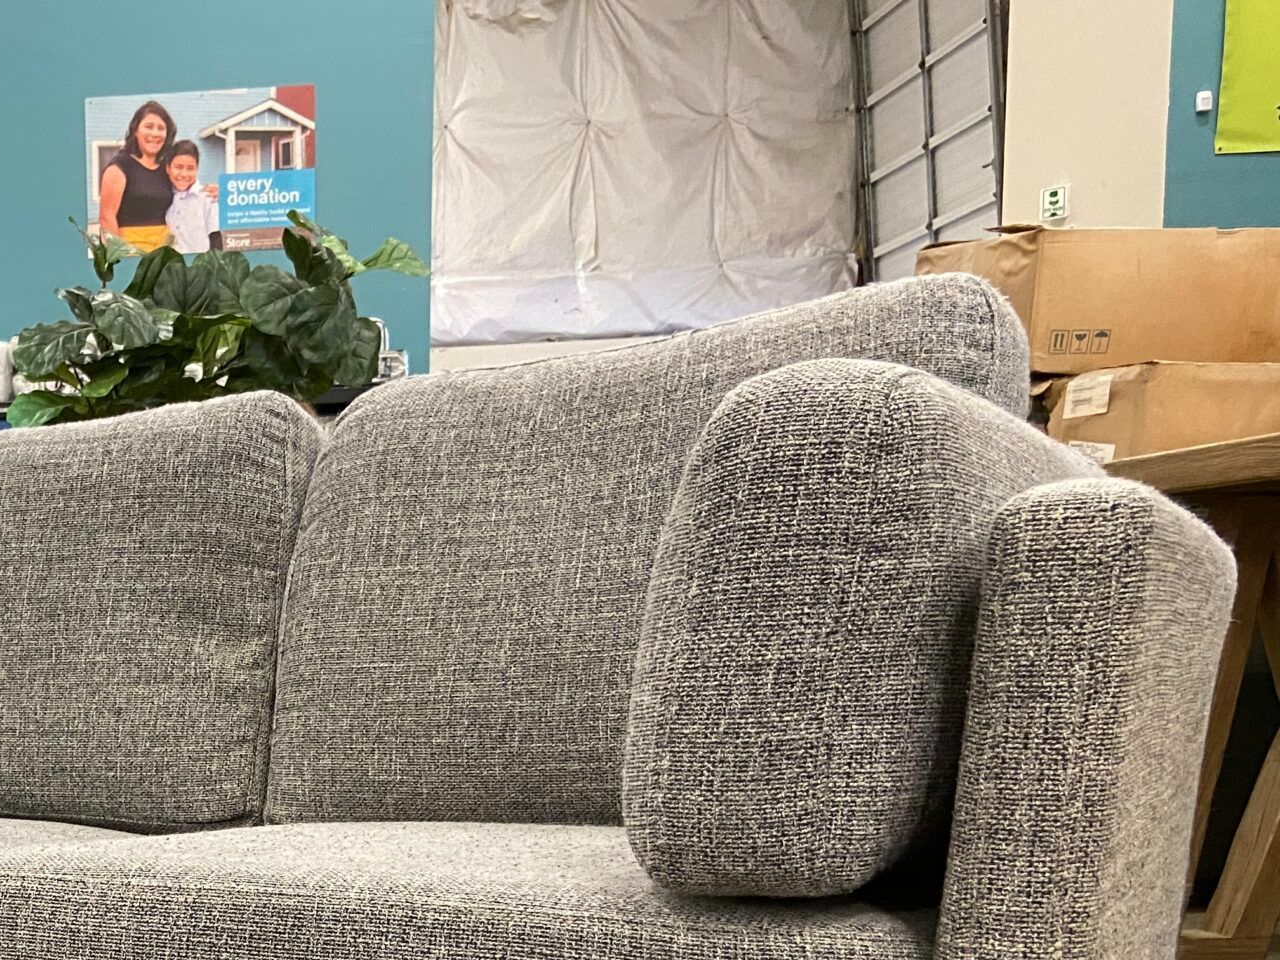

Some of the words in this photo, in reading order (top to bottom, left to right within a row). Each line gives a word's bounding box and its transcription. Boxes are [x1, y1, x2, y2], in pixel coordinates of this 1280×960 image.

[226, 177, 273, 192] every
[227, 188, 300, 206] donation
[225, 237, 251, 249] Store
